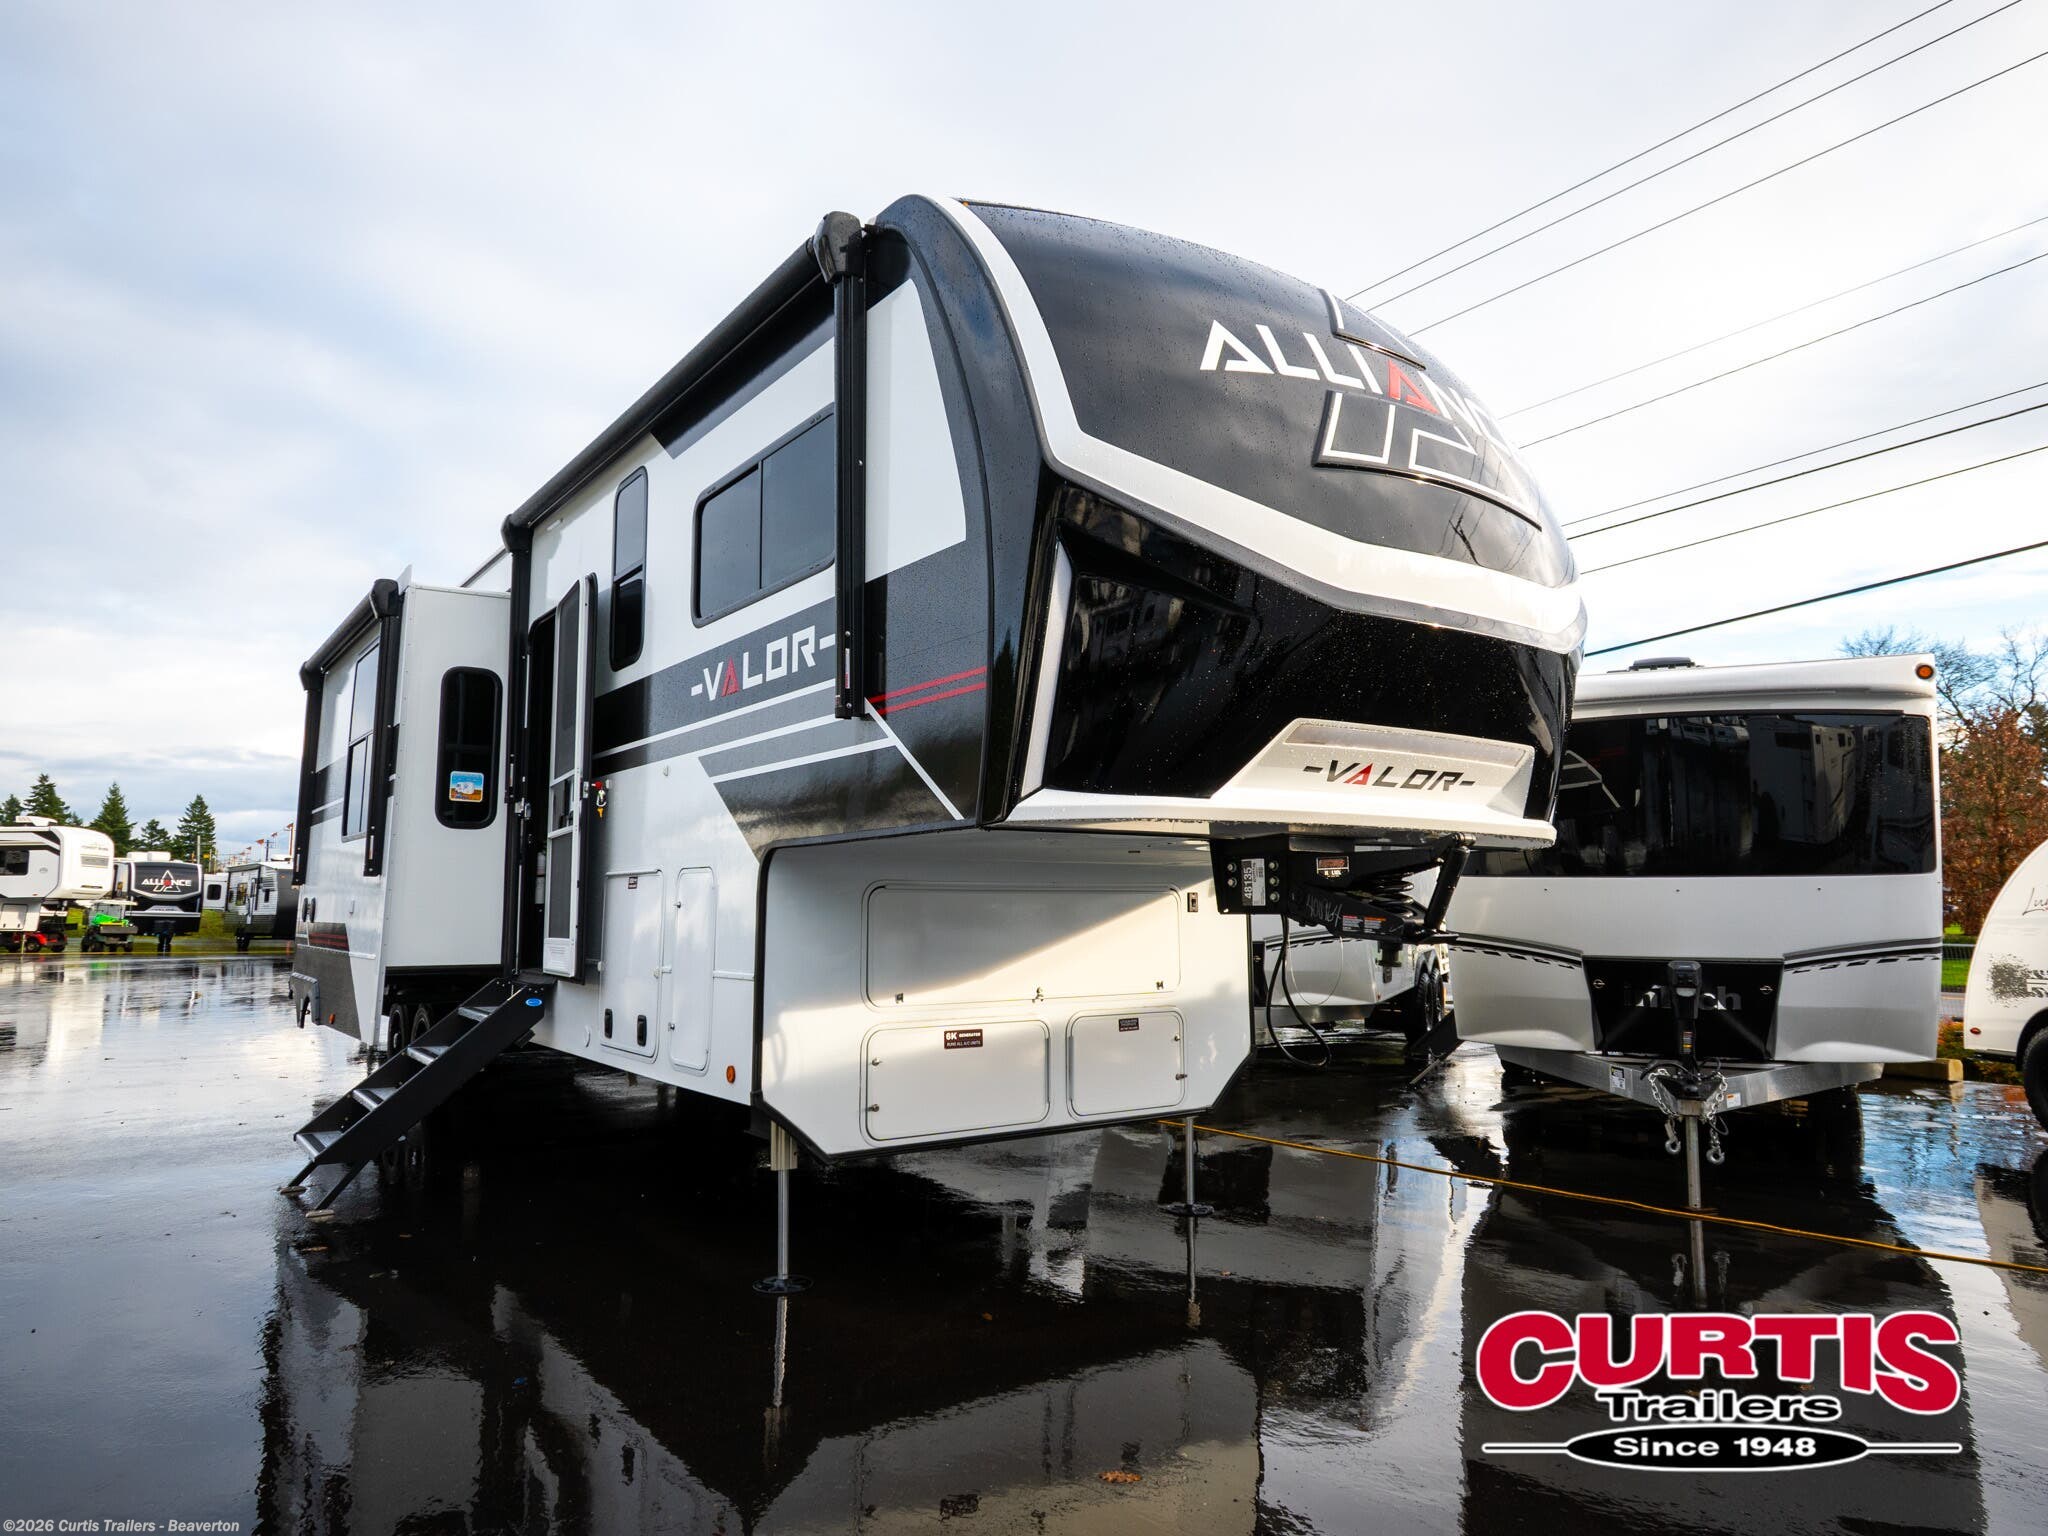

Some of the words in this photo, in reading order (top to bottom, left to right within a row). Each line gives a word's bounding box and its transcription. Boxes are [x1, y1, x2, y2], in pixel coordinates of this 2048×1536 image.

[1200, 319, 1512, 457] ALLIANC
[1243, 867, 1252, 899] 48135
[945, 1032, 957, 1041] 6K
